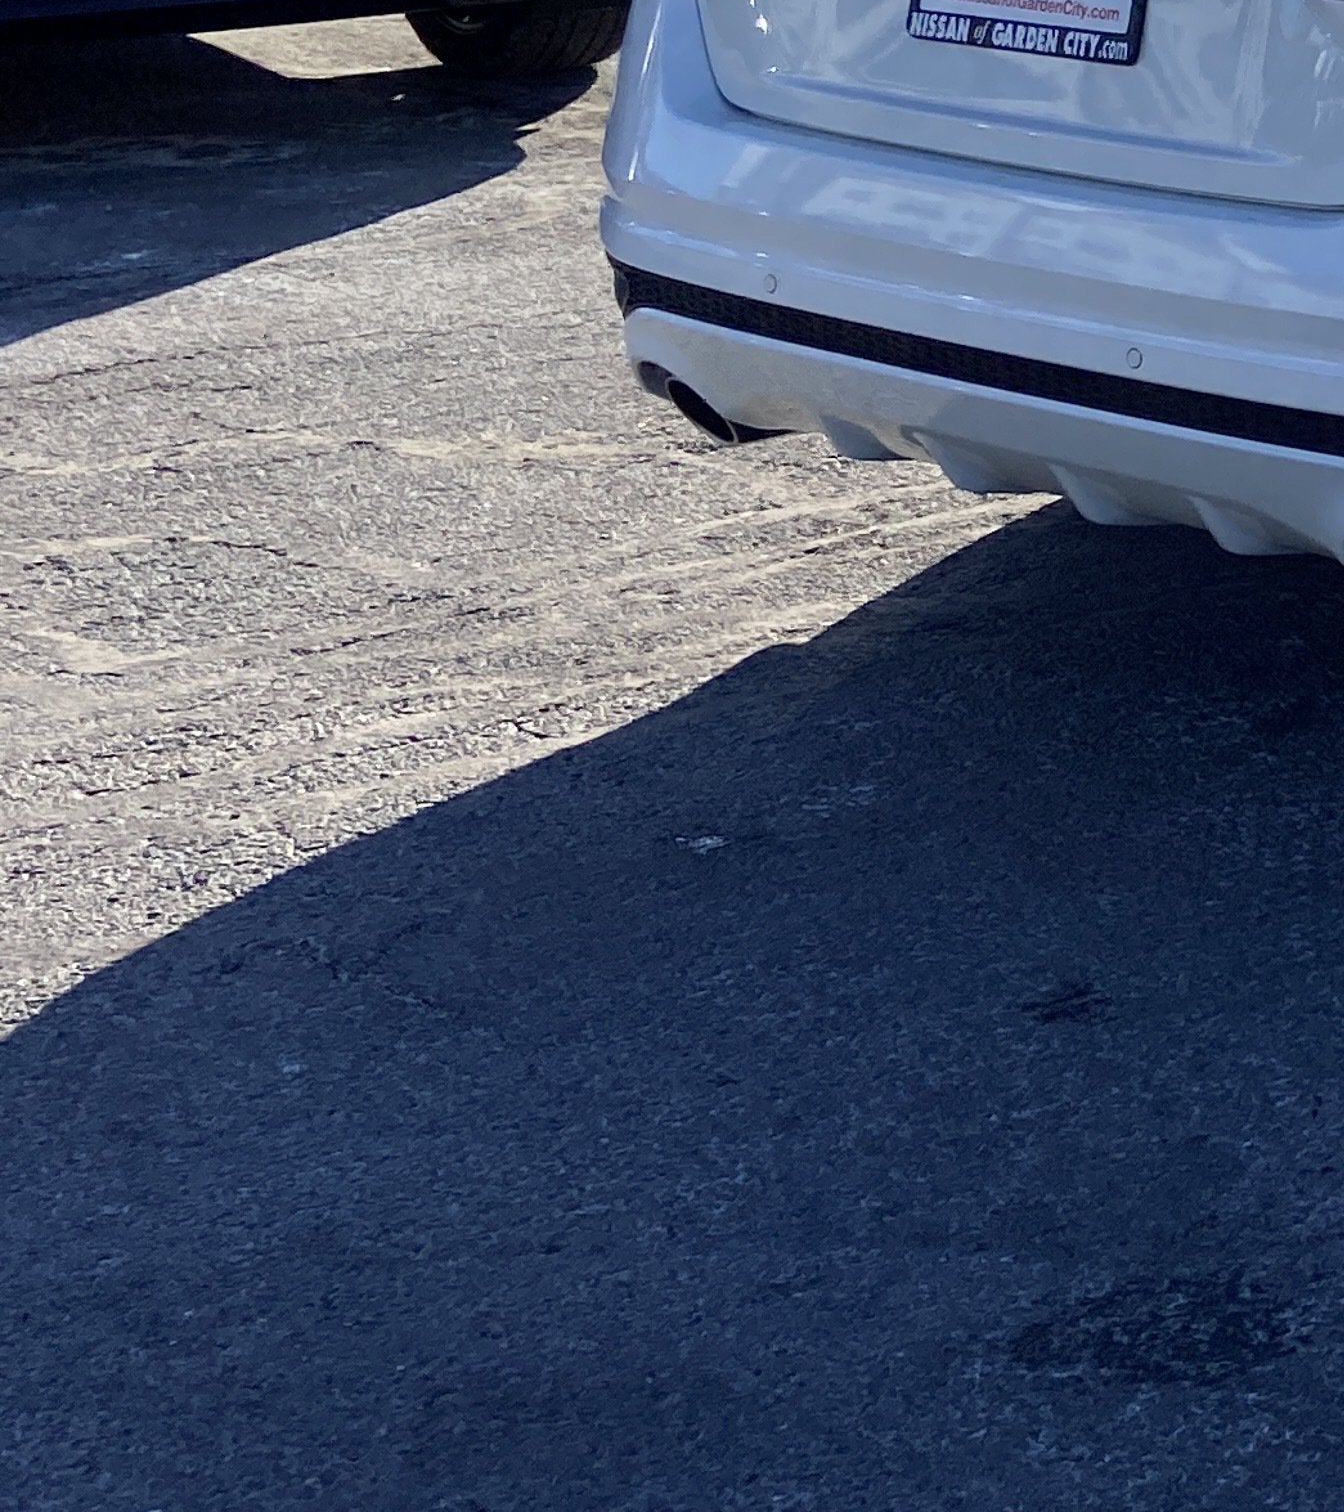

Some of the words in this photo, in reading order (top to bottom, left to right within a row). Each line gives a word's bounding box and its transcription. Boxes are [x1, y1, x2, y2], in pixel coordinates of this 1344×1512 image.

[909, 11, 971, 42] NISSAN
[974, 20, 988, 45] of
[991, 22, 1060, 54] GARDEN
